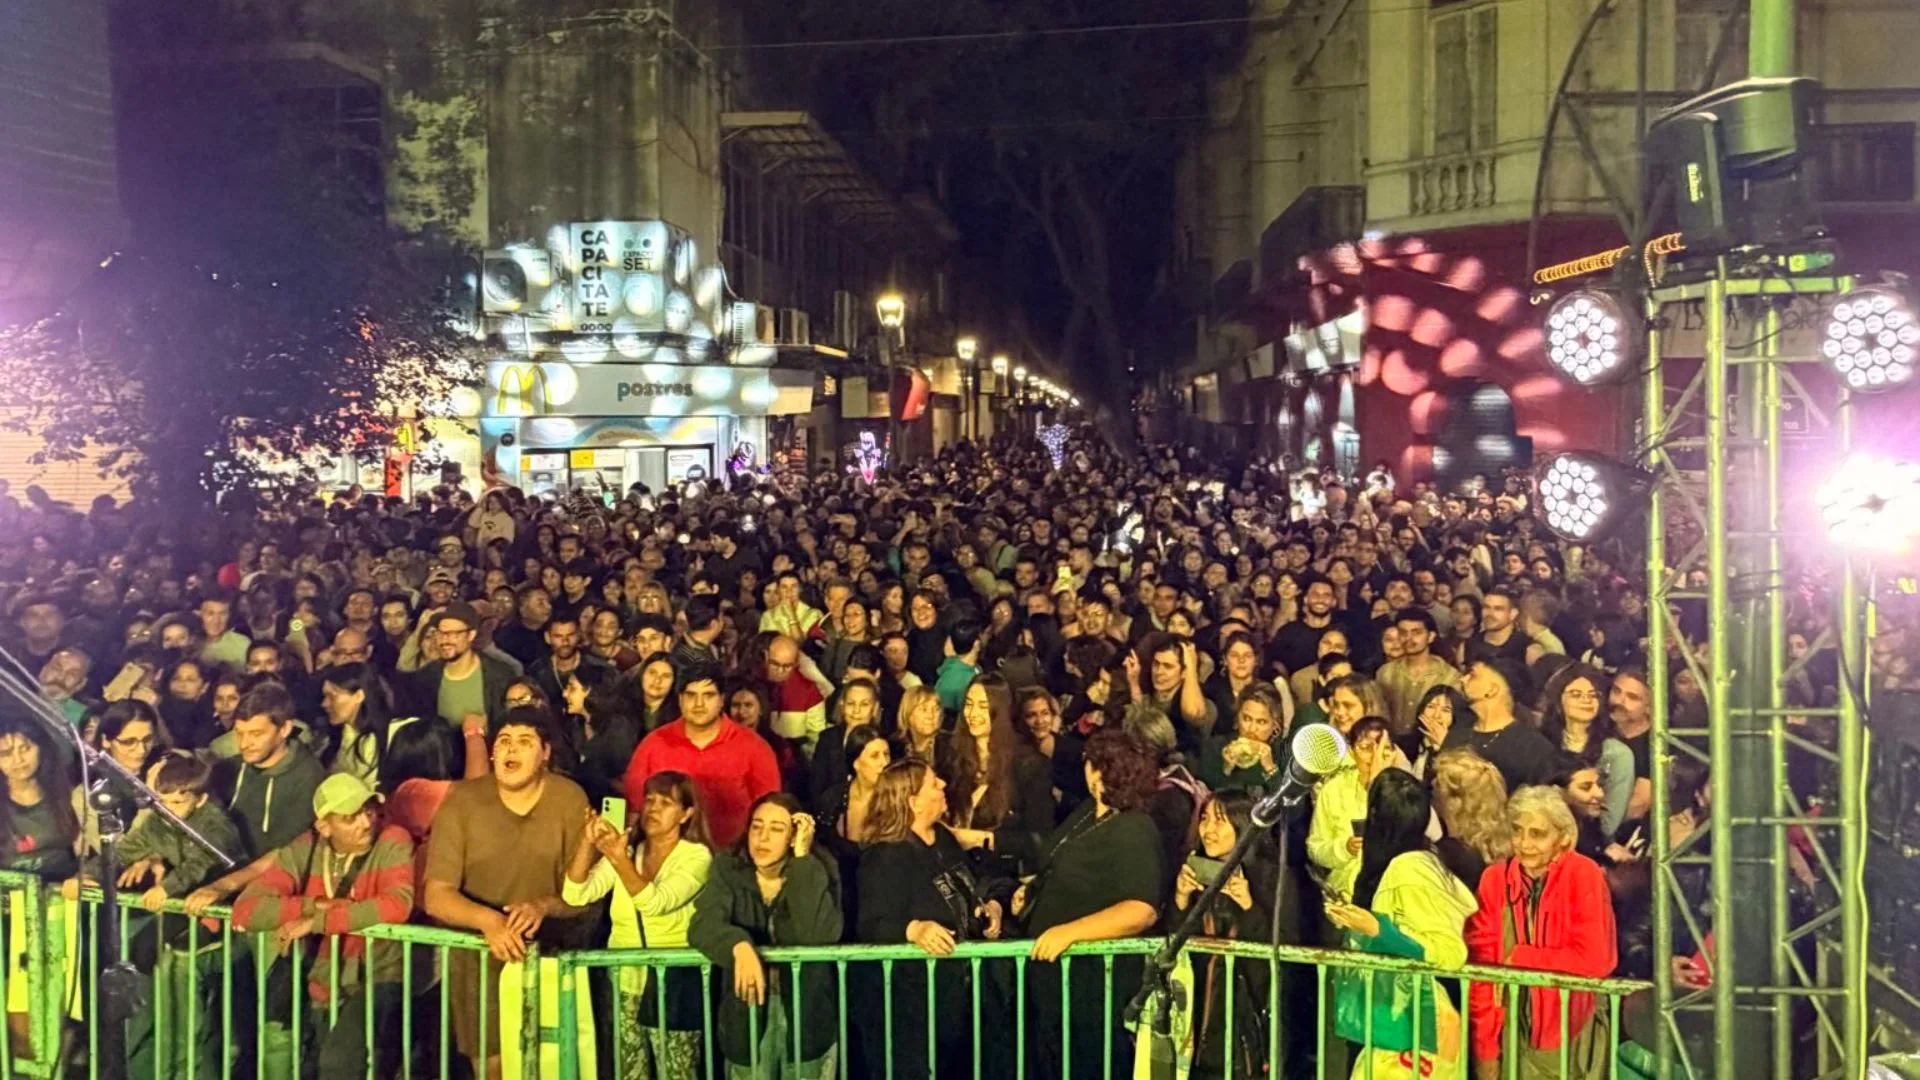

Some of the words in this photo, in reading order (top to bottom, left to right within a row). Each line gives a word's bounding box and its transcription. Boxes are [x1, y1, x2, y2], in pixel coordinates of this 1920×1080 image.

[581, 230, 609, 245] CA
[581, 248, 609, 263] PA
[623, 257, 652, 271] SET
[582, 266, 602, 281] CI
[581, 283, 609, 298] TA
[581, 302, 608, 317] TE
[617, 382, 694, 402] postres
